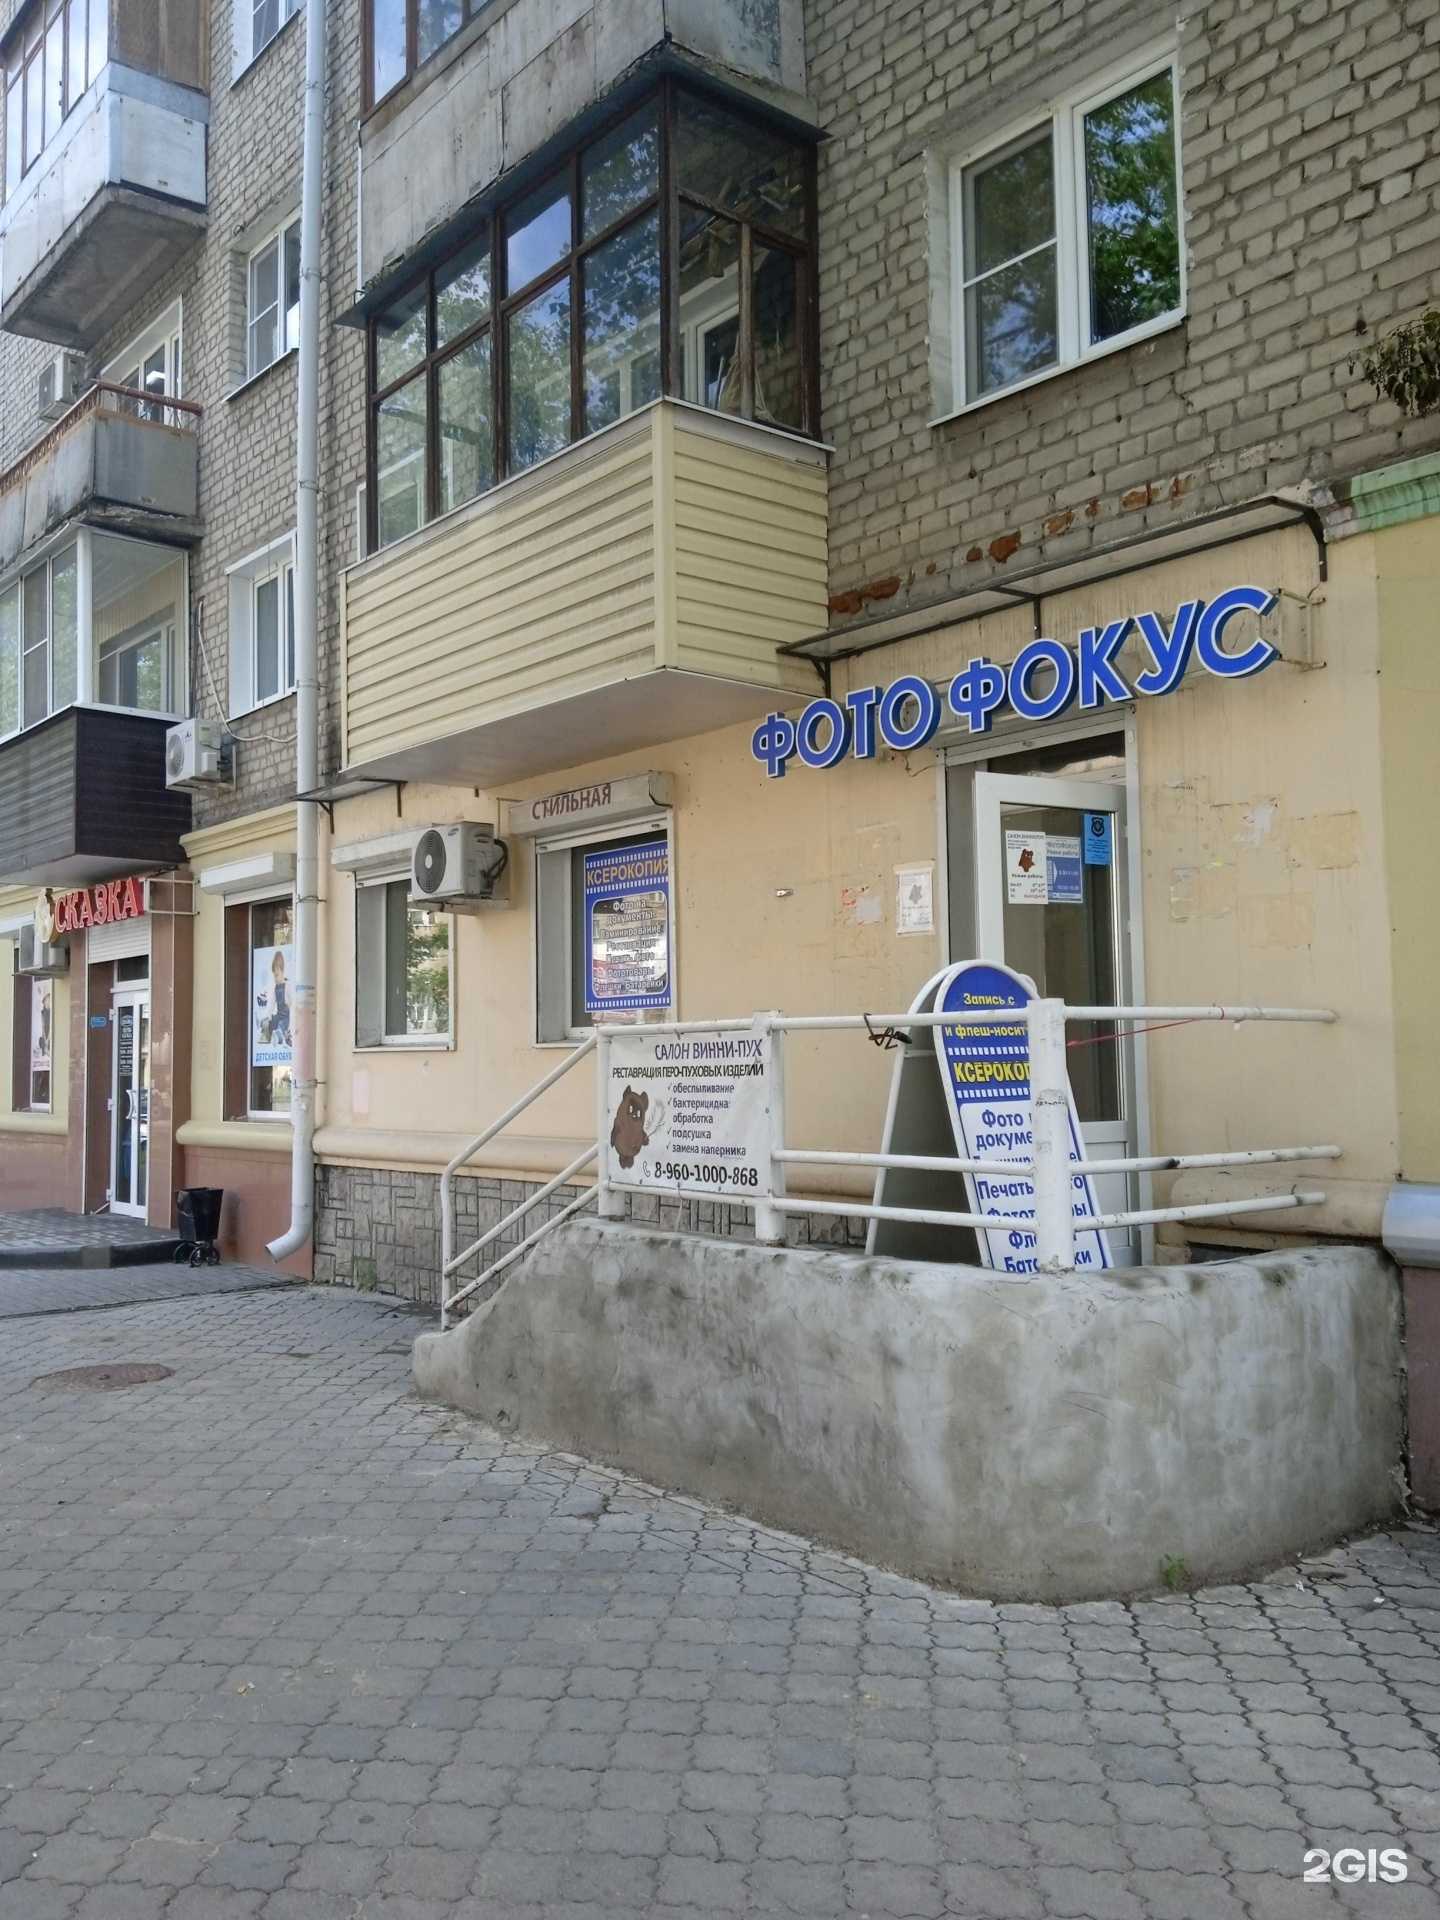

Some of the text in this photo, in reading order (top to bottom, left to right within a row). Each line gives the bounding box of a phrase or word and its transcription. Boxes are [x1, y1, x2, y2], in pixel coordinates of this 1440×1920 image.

[751, 585, 1281, 777] ФОТО ФОКУС
[532, 783, 612, 820] СТИЛЬНАЯ
[586, 857, 668, 887] КСЕРОКОПИЯ
[54, 877, 140, 933] СКАЗКА
[963, 993, 1015, 1005] Запись с
[944, 1024, 1027, 1039] и флеш-носит
[655, 1039, 763, 1060] САЛОН ВИННИ-ПУХ
[612, 1067, 662, 1080] РЕСТАВРАЦИЯ
[662, 1065, 722, 1079] ПЕРО-ПУХОВЫХ
[953, 1062, 1032, 1083] КСЕРОКОП
[672, 1082, 735, 1094] обеспыливание
[672, 1098, 730, 1111] бактерицидна
[672, 1112, 714, 1125] обработка
[982, 1109, 1024, 1128] Фото
[672, 1129, 712, 1141] подсушка
[976, 1131, 1032, 1151] докуме
[672, 1144, 747, 1157] замена наперника
[654, 1161, 759, 1187] 8-960-1000-868
[977, 1181, 1034, 1200] Печать
